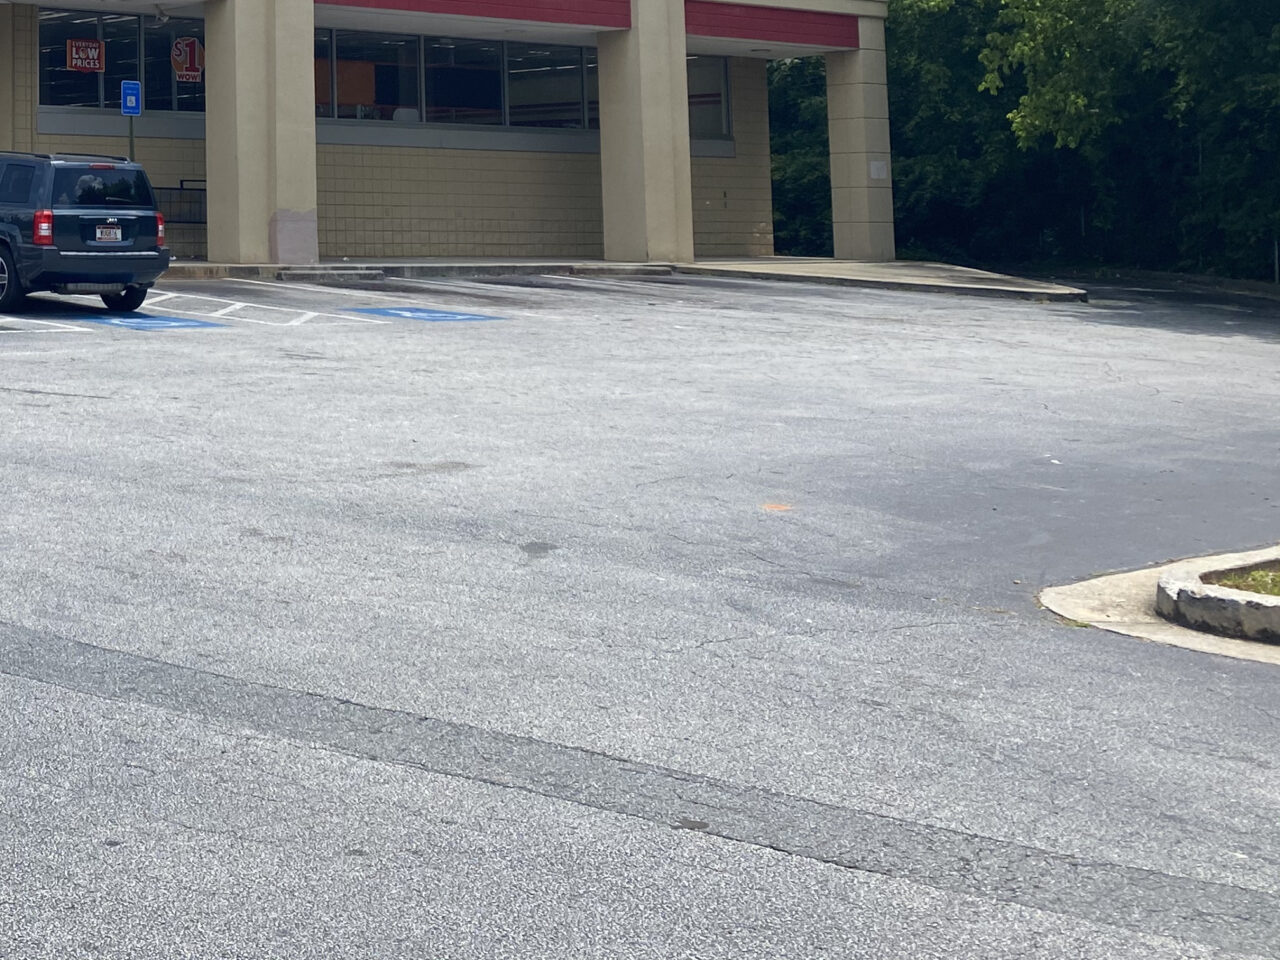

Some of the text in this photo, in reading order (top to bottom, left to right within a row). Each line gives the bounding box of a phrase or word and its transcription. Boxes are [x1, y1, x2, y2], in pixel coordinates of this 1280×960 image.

[72, 41, 99, 49] EVERYDAY
[72, 47, 100, 59] LOW
[173, 38, 202, 73] $1
[72, 59, 100, 69] PRICES
